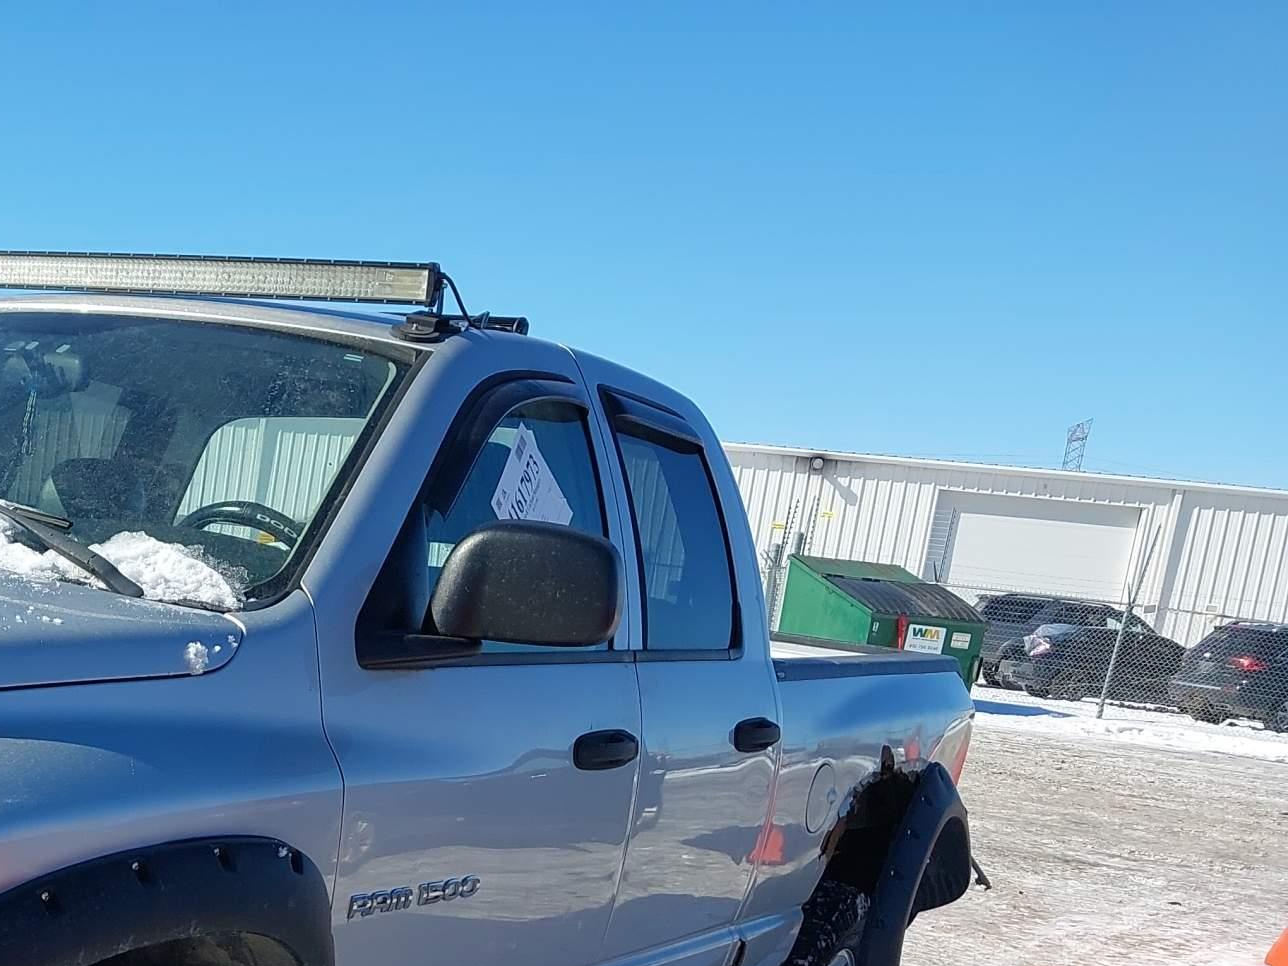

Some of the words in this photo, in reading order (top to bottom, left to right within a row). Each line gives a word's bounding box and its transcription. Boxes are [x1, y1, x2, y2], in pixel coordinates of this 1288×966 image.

[912, 627, 941, 640] WM
[346, 886, 414, 921] RAM
[416, 874, 482, 907] 1500
